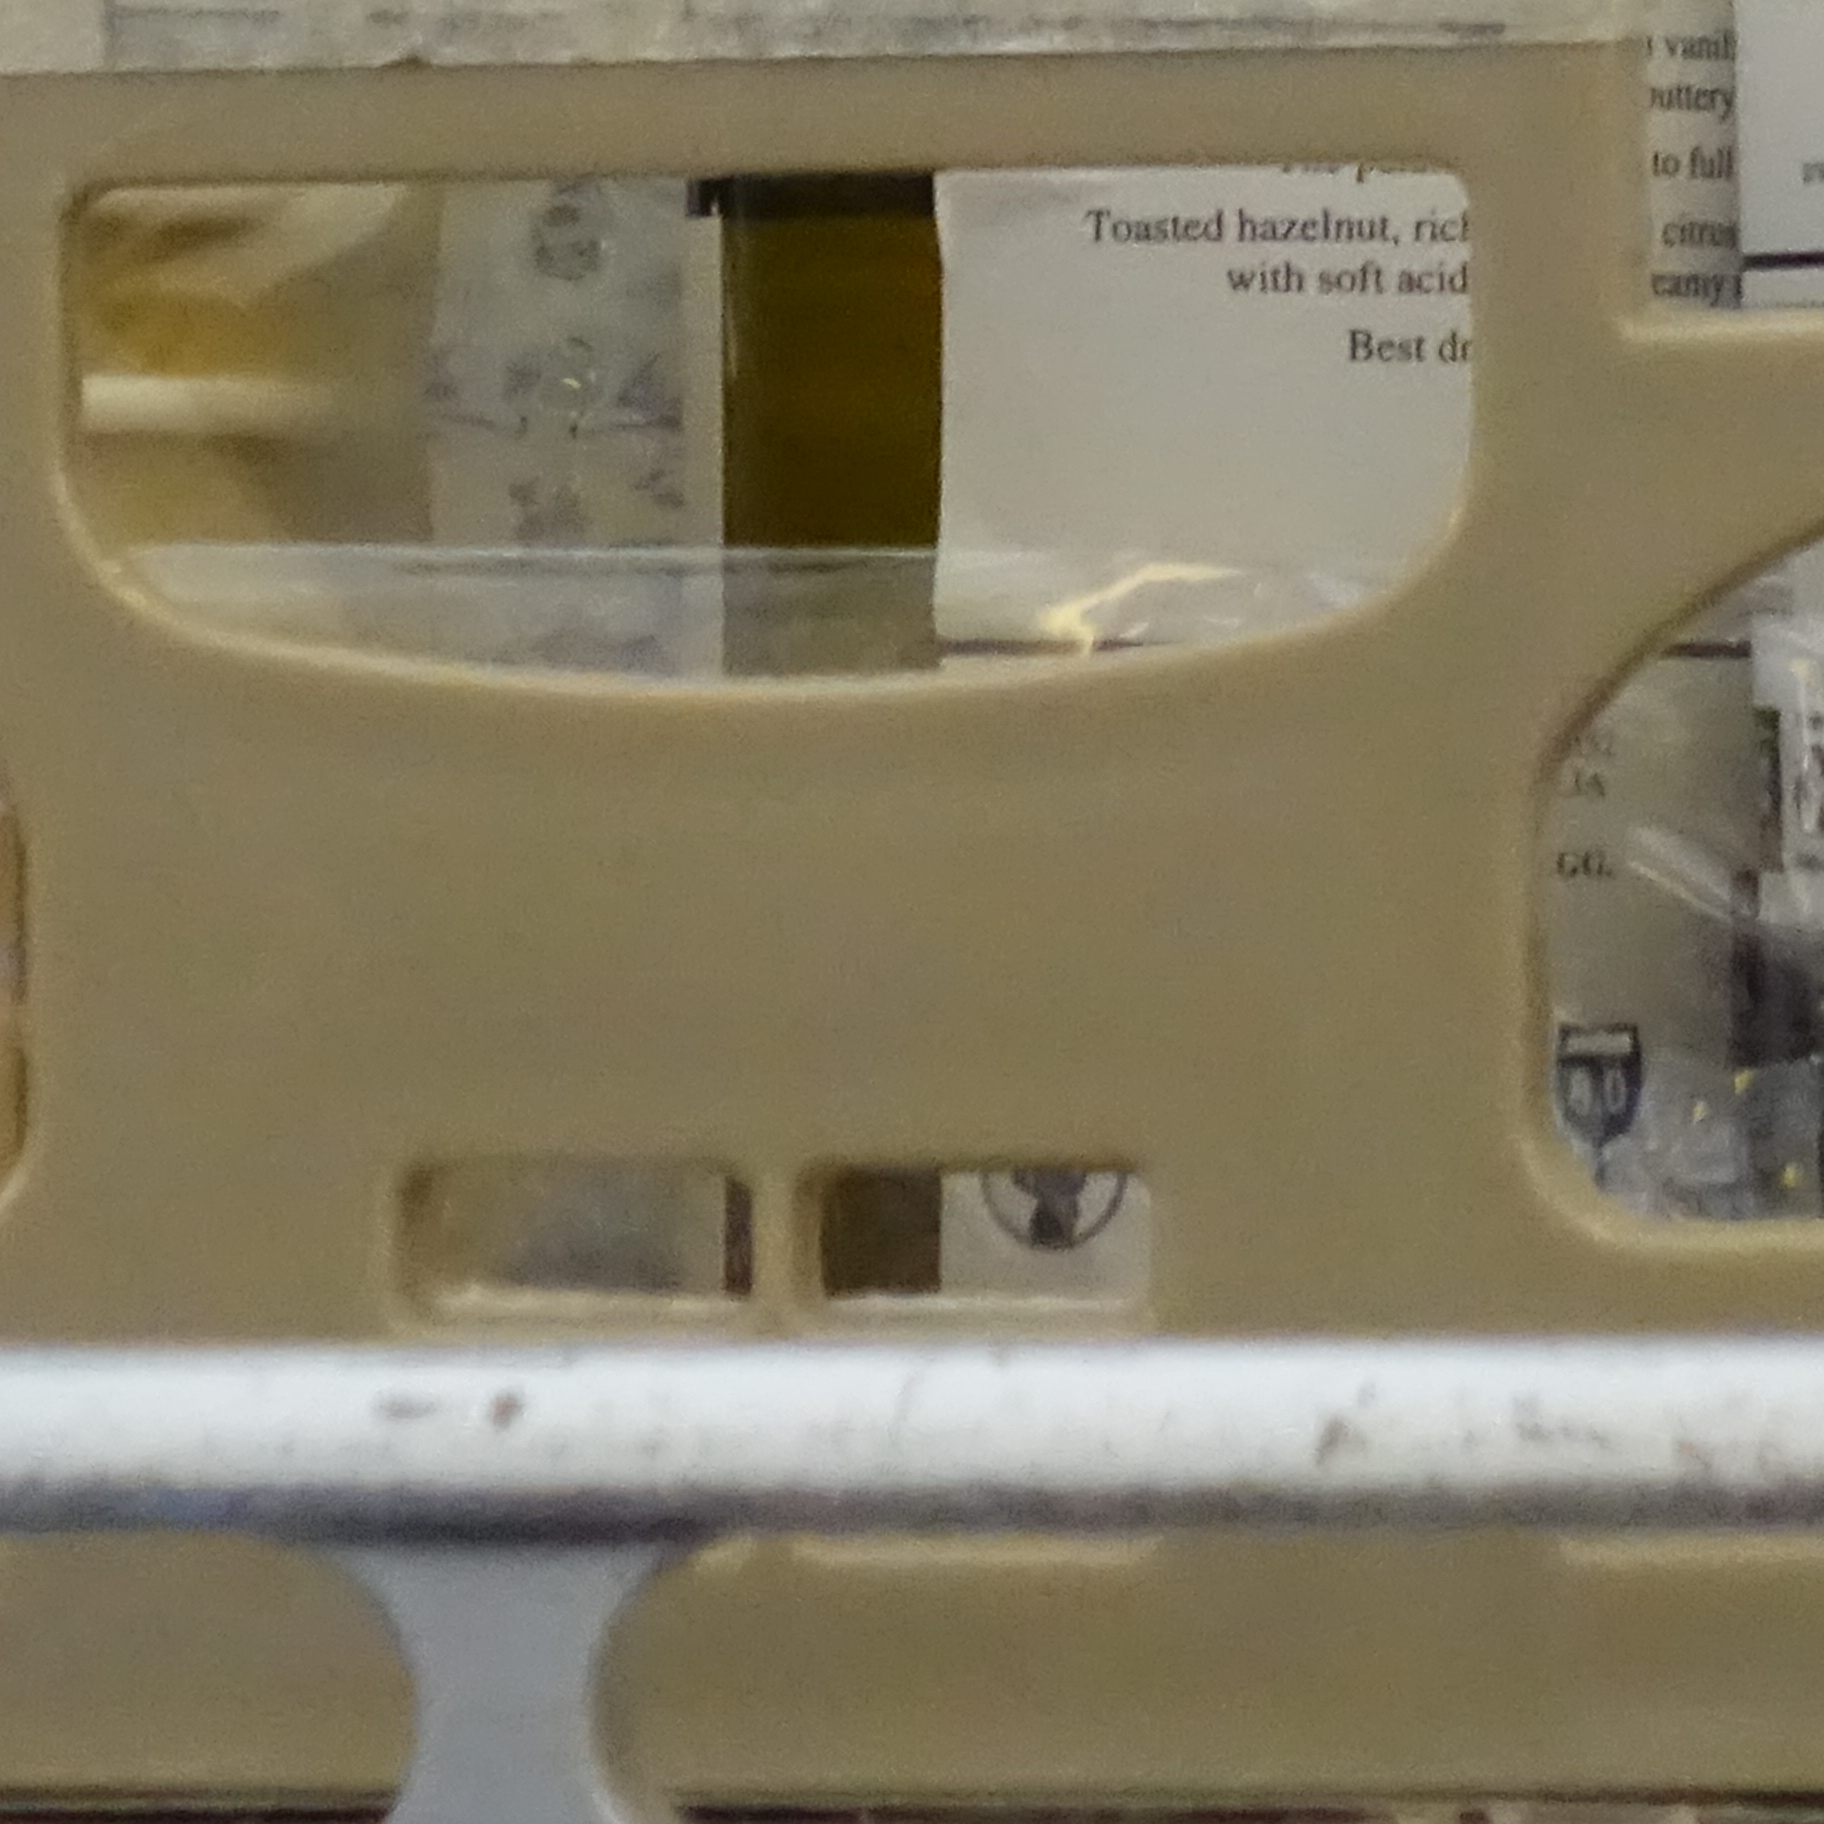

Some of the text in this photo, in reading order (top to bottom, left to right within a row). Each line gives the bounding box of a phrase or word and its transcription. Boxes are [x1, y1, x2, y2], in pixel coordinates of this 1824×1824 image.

[1085, 208, 1225, 244] Toasted
[1238, 207, 1400, 247] hazelnut,
[1227, 261, 1468, 294] with soft acid
[1348, 328, 1426, 364] Best
